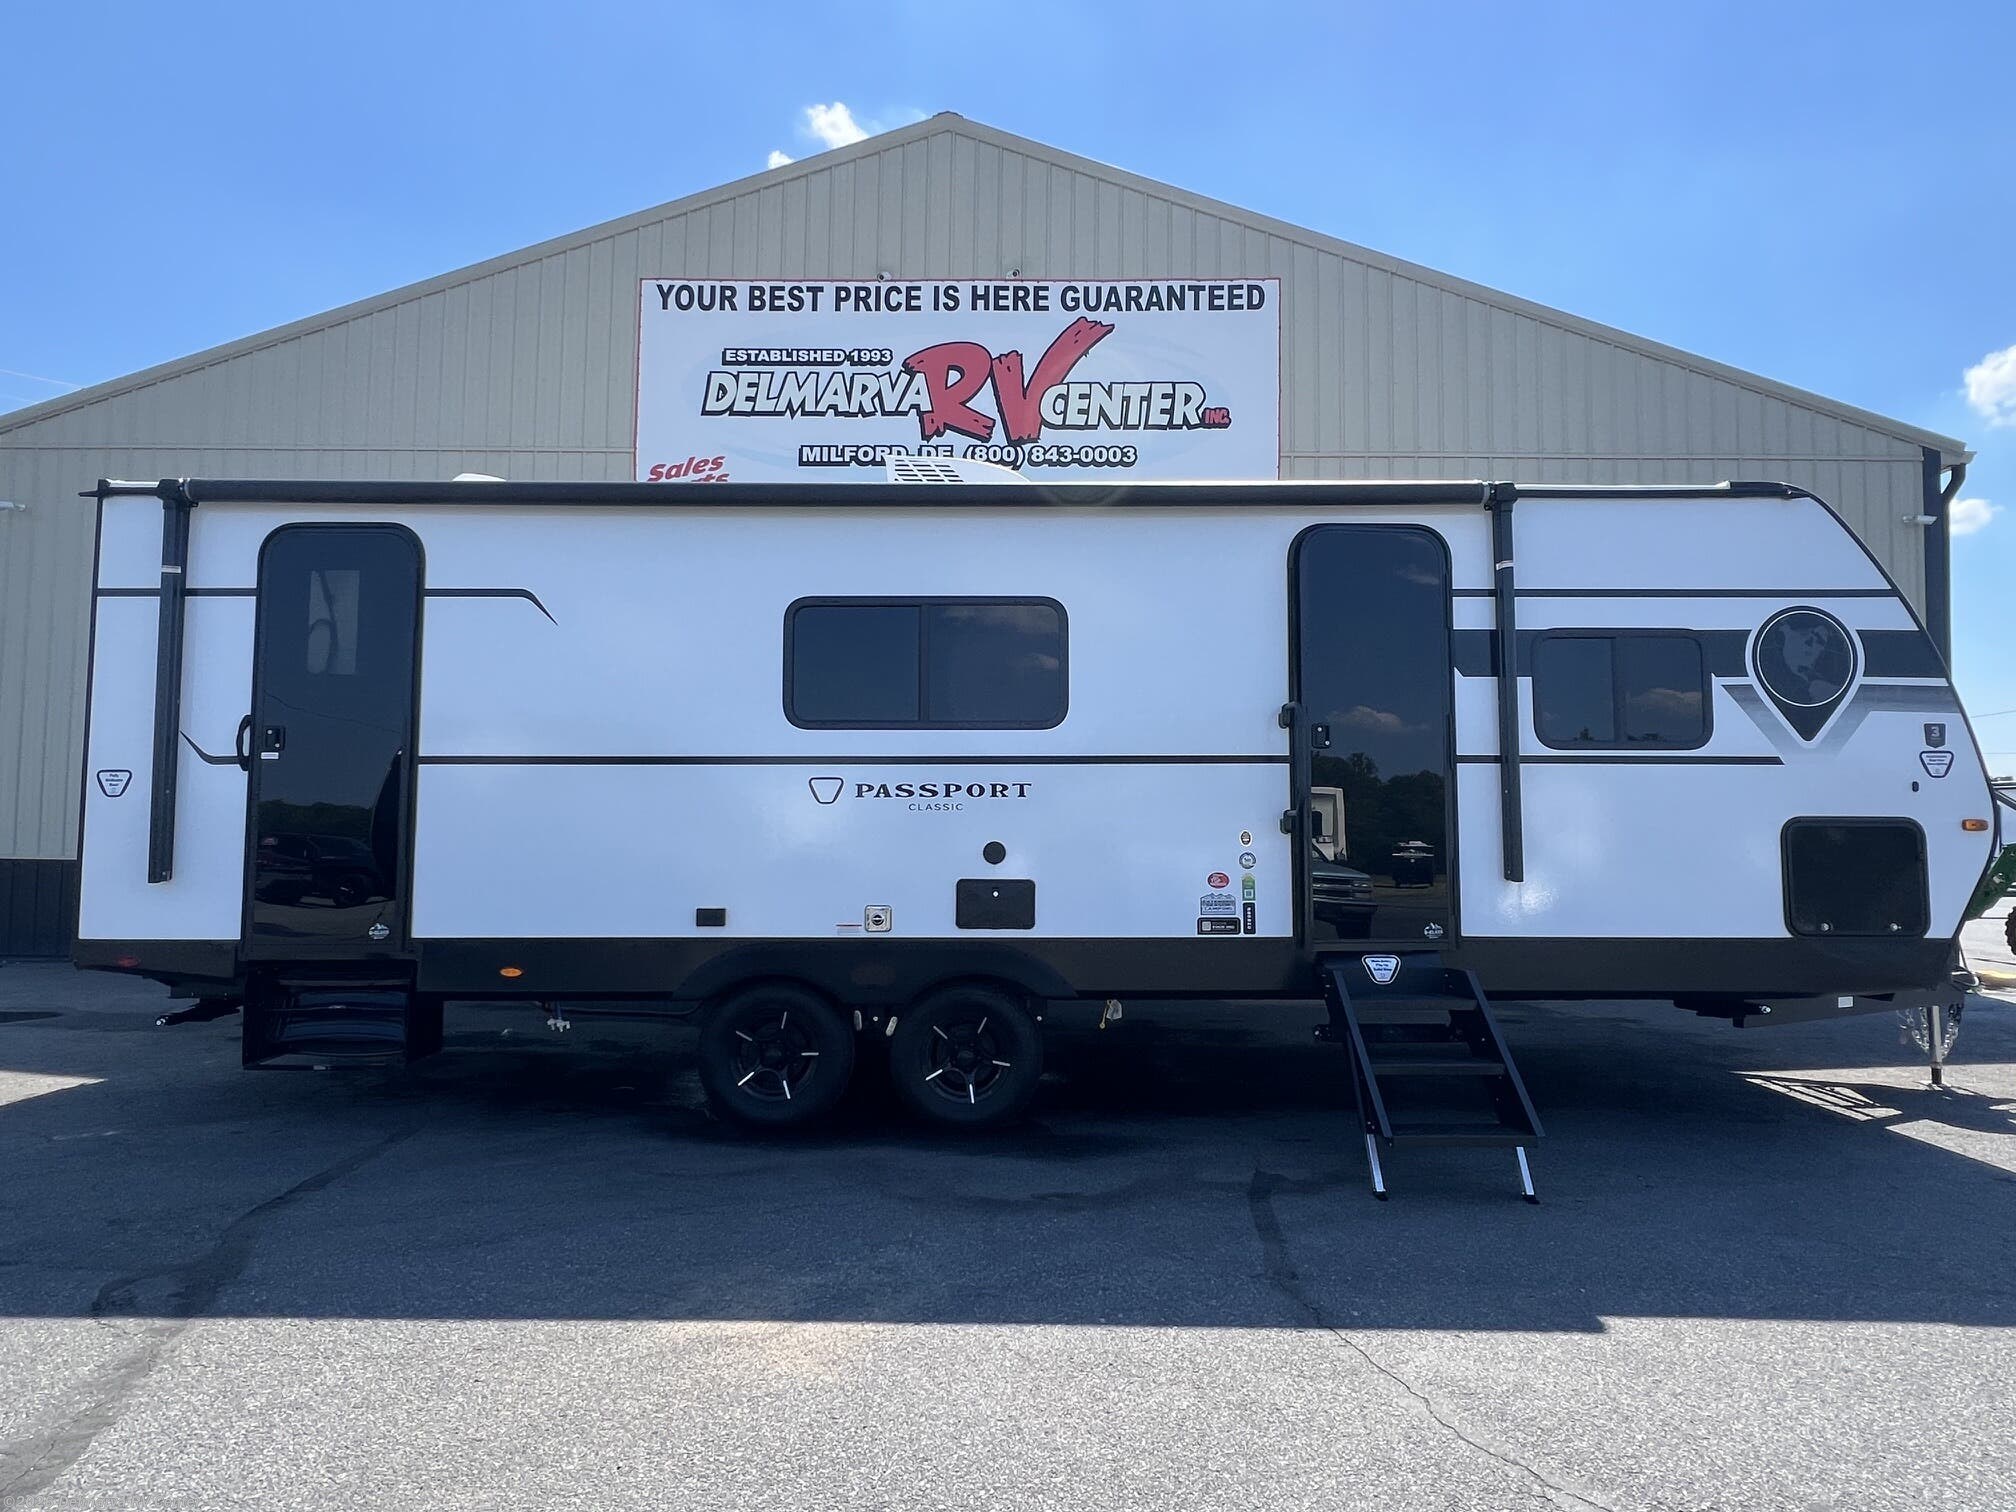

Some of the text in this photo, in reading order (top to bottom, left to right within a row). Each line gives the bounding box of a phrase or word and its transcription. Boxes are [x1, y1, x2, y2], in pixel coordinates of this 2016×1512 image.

[656, 284, 1265, 312] YOUR BEST PRICE IS HERE GUARANTEED
[723, 349, 893, 363] ESTABLISHED 1993
[702, 371, 933, 416] DELMARVA
[902, 317, 1115, 443] RV
[1040, 382, 1205, 427] CENTER
[800, 445, 1136, 467] MILFORD DE (800) 843-0003
[1930, 726, 1940, 737] 3
[855, 783, 1032, 798] PASSPORT
[908, 803, 964, 811] CLASSIC
